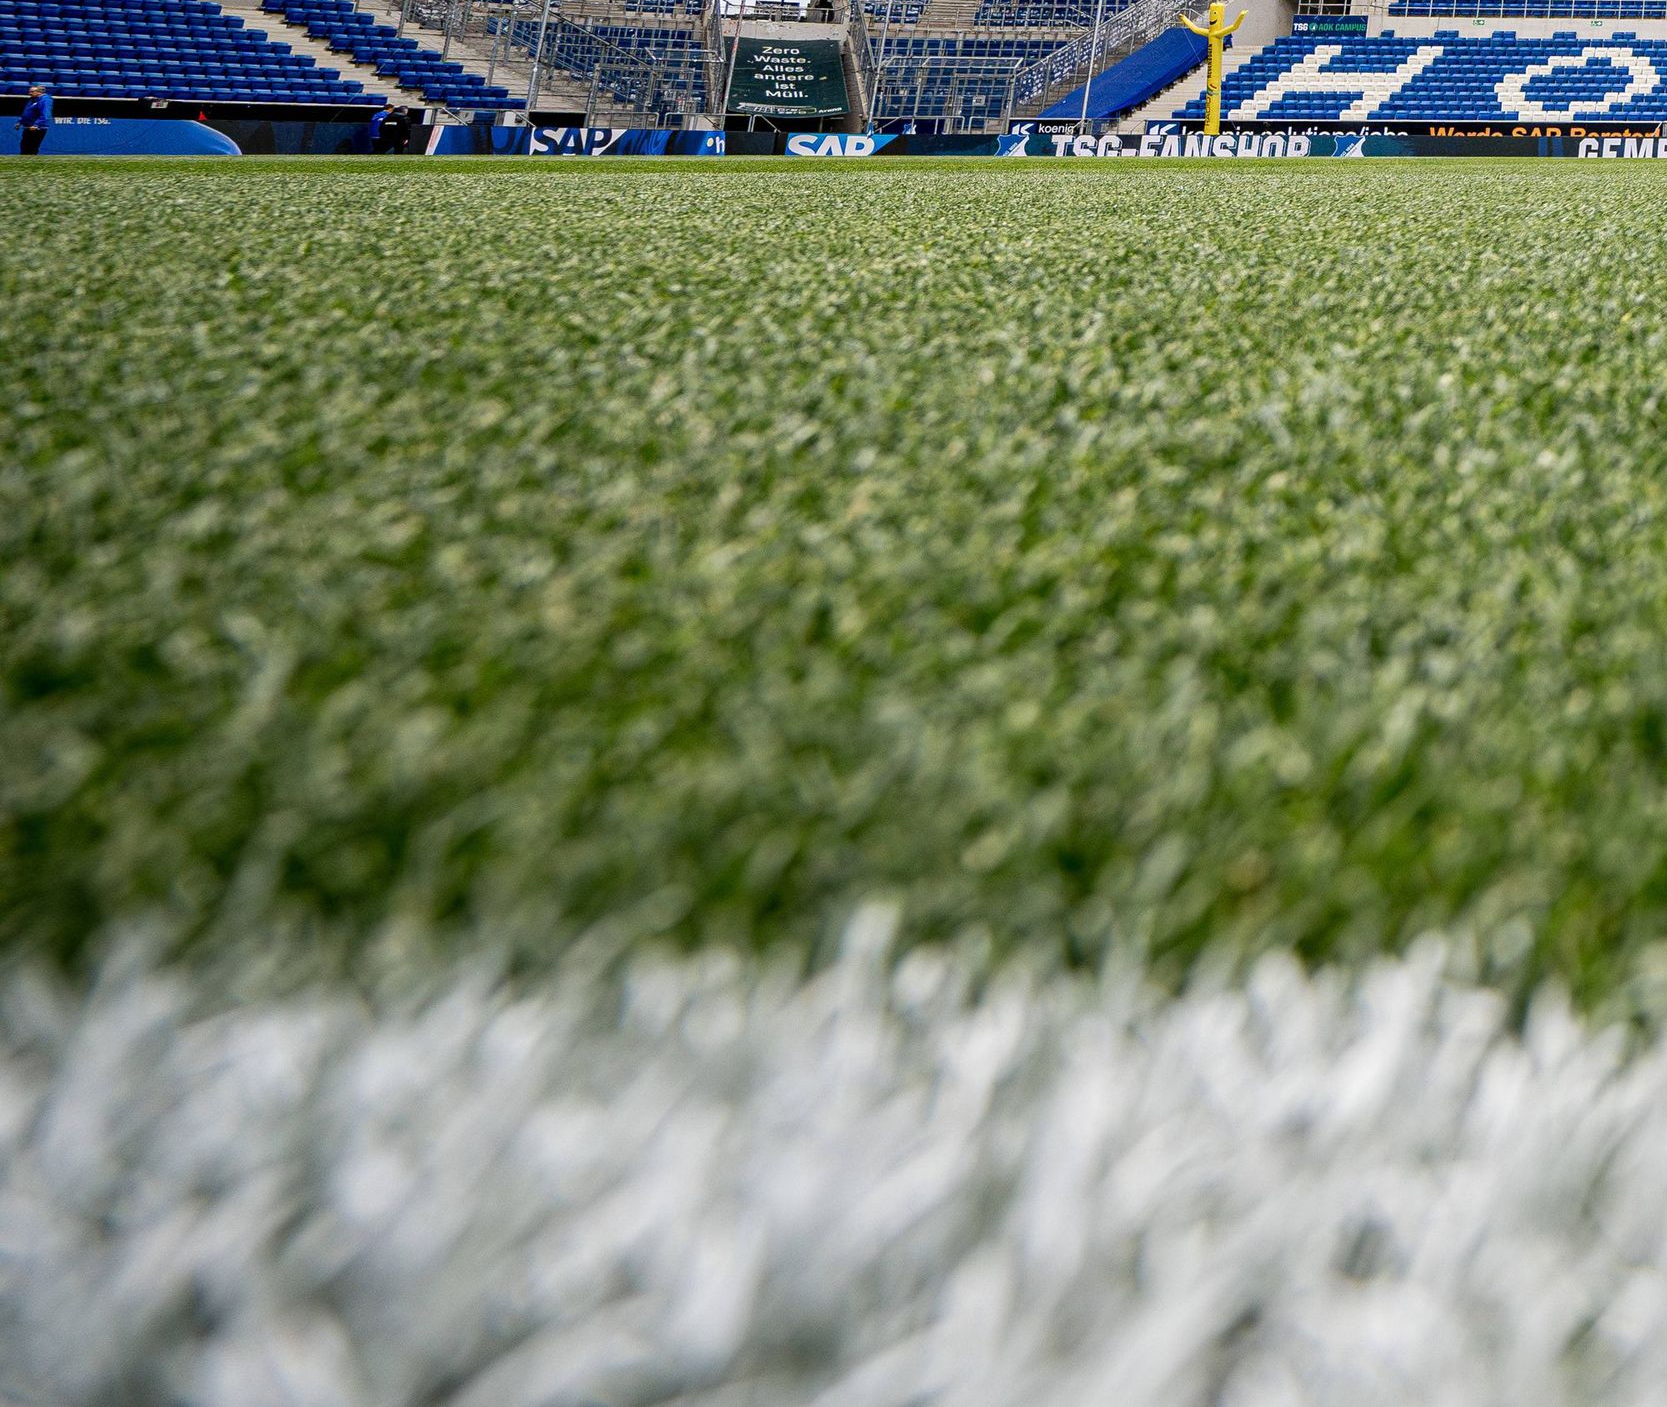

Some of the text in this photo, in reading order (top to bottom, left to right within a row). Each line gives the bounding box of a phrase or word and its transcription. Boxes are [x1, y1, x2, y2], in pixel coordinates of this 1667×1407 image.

[1293, 23, 1367, 31] TSG AOK CAMPUS
[762, 46, 800, 55] Zero
[753, 55, 811, 64] Waste.
[762, 64, 804, 73] Alles
[754, 73, 815, 81] andere
[775, 82, 796, 90] ist
[765, 90, 809, 98] Müll.
[533, 127, 612, 155] SAP
[787, 134, 875, 156] SAP
